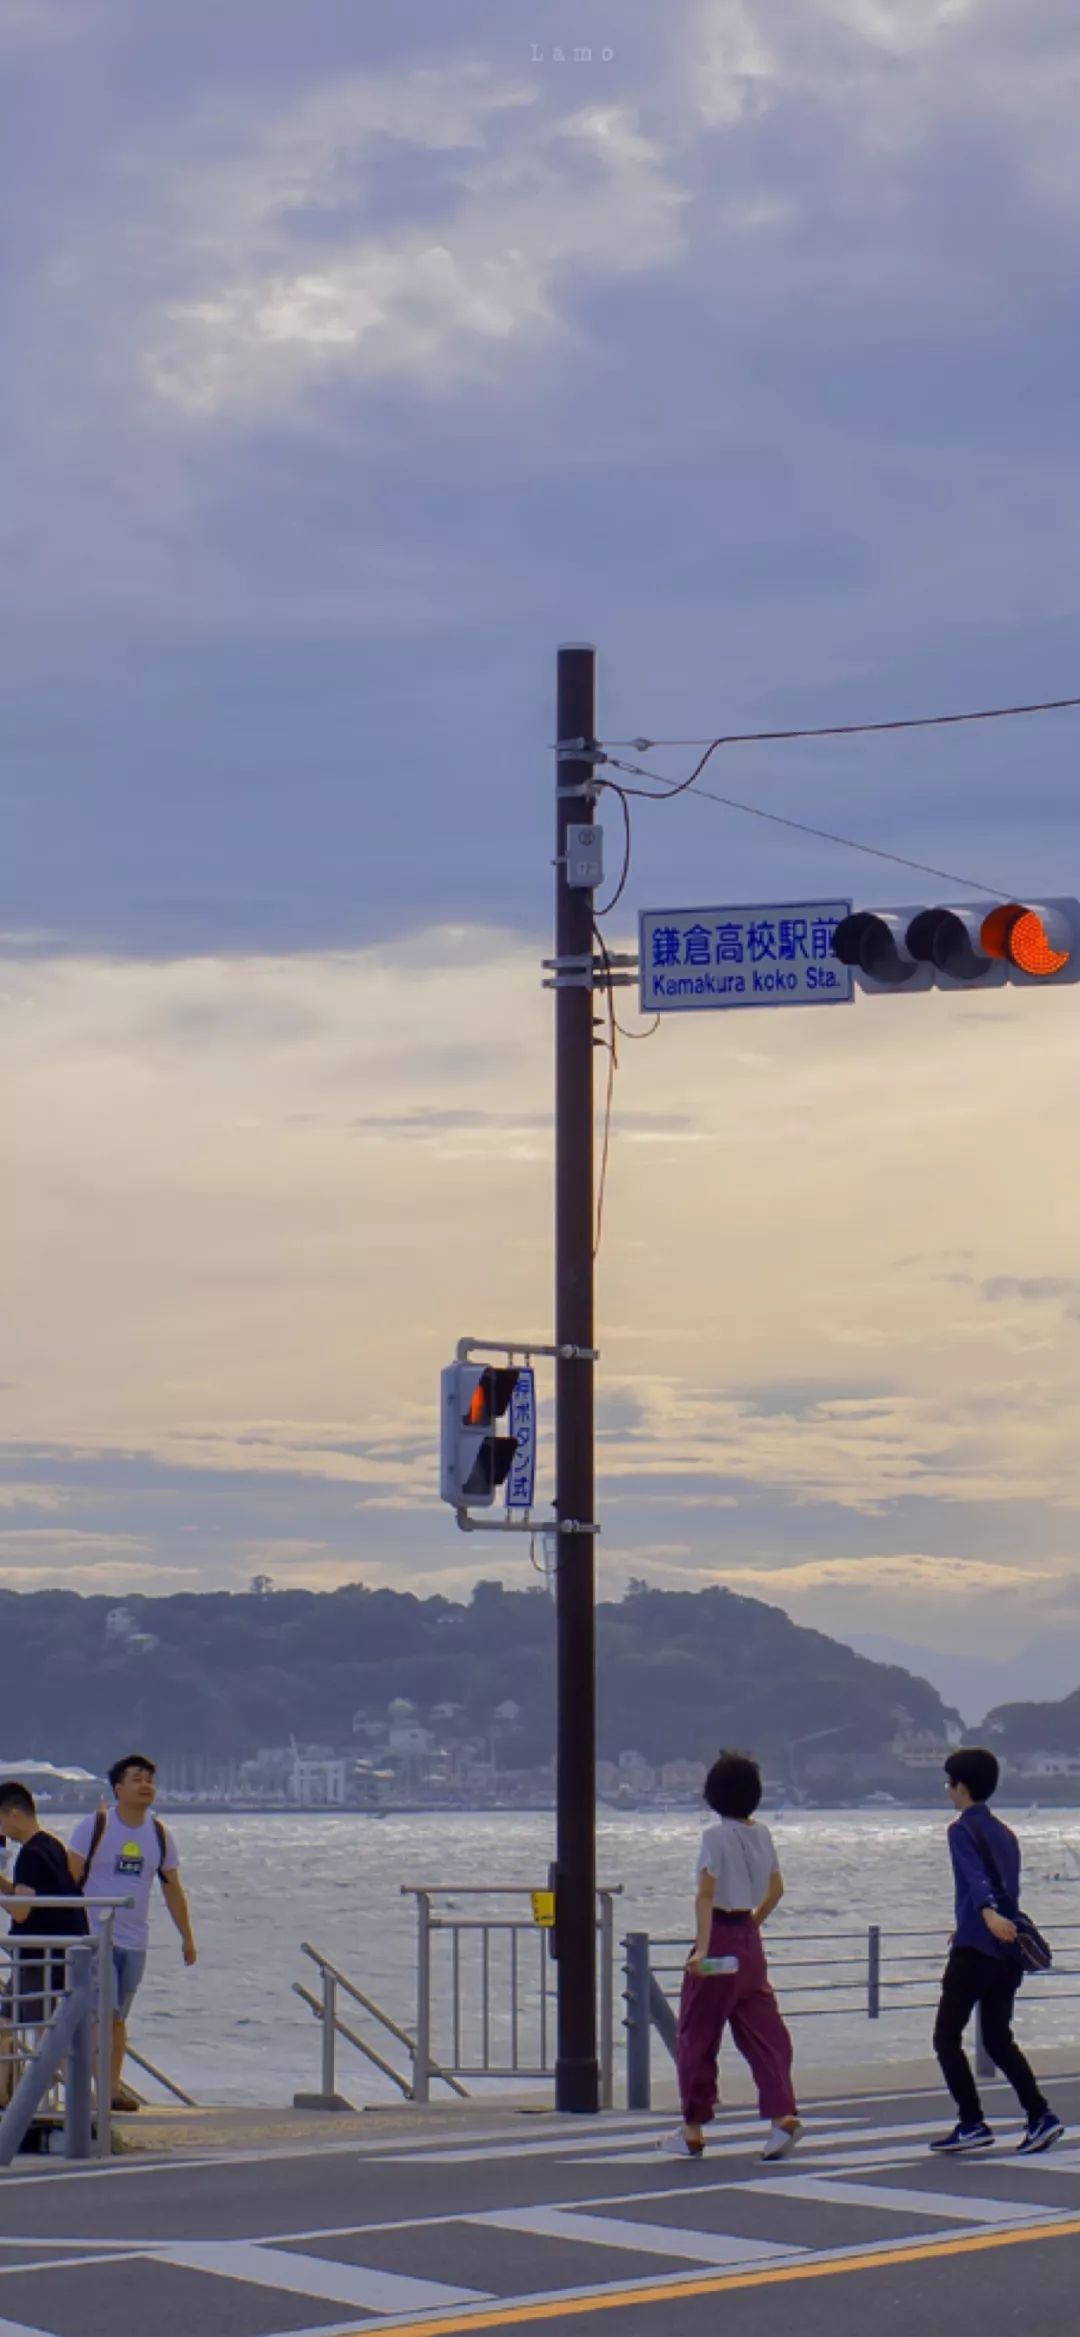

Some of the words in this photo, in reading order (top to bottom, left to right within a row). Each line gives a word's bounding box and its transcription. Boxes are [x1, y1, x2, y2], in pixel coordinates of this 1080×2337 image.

[652, 917, 838, 967] 鎌倉高校駅前
[653, 973, 745, 996] Kamakura
[752, 969, 798, 992] koko
[806, 966, 840, 990] Sta.
